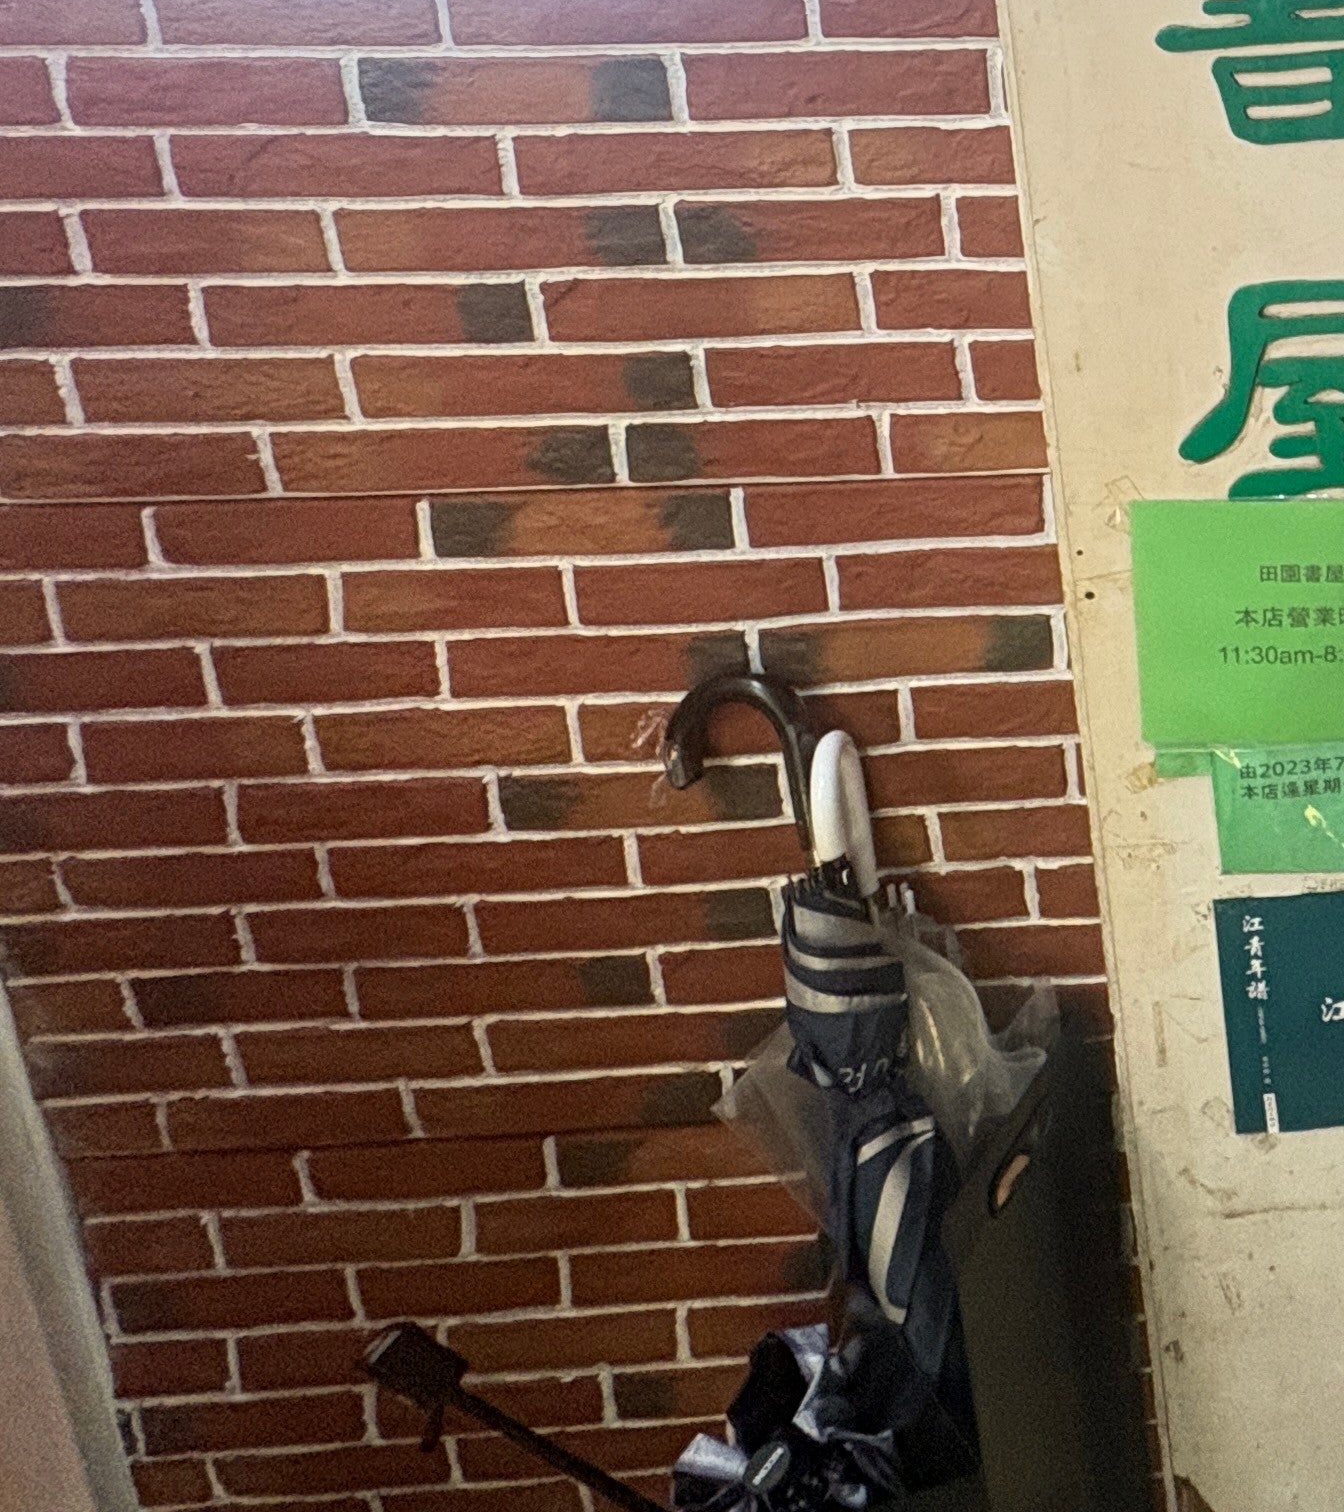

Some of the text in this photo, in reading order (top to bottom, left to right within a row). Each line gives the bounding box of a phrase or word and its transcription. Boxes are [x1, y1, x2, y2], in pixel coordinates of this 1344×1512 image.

[1259, 563, 1344, 584] 田園書屋
[1241, 914, 1270, 1001] 江青年譜
